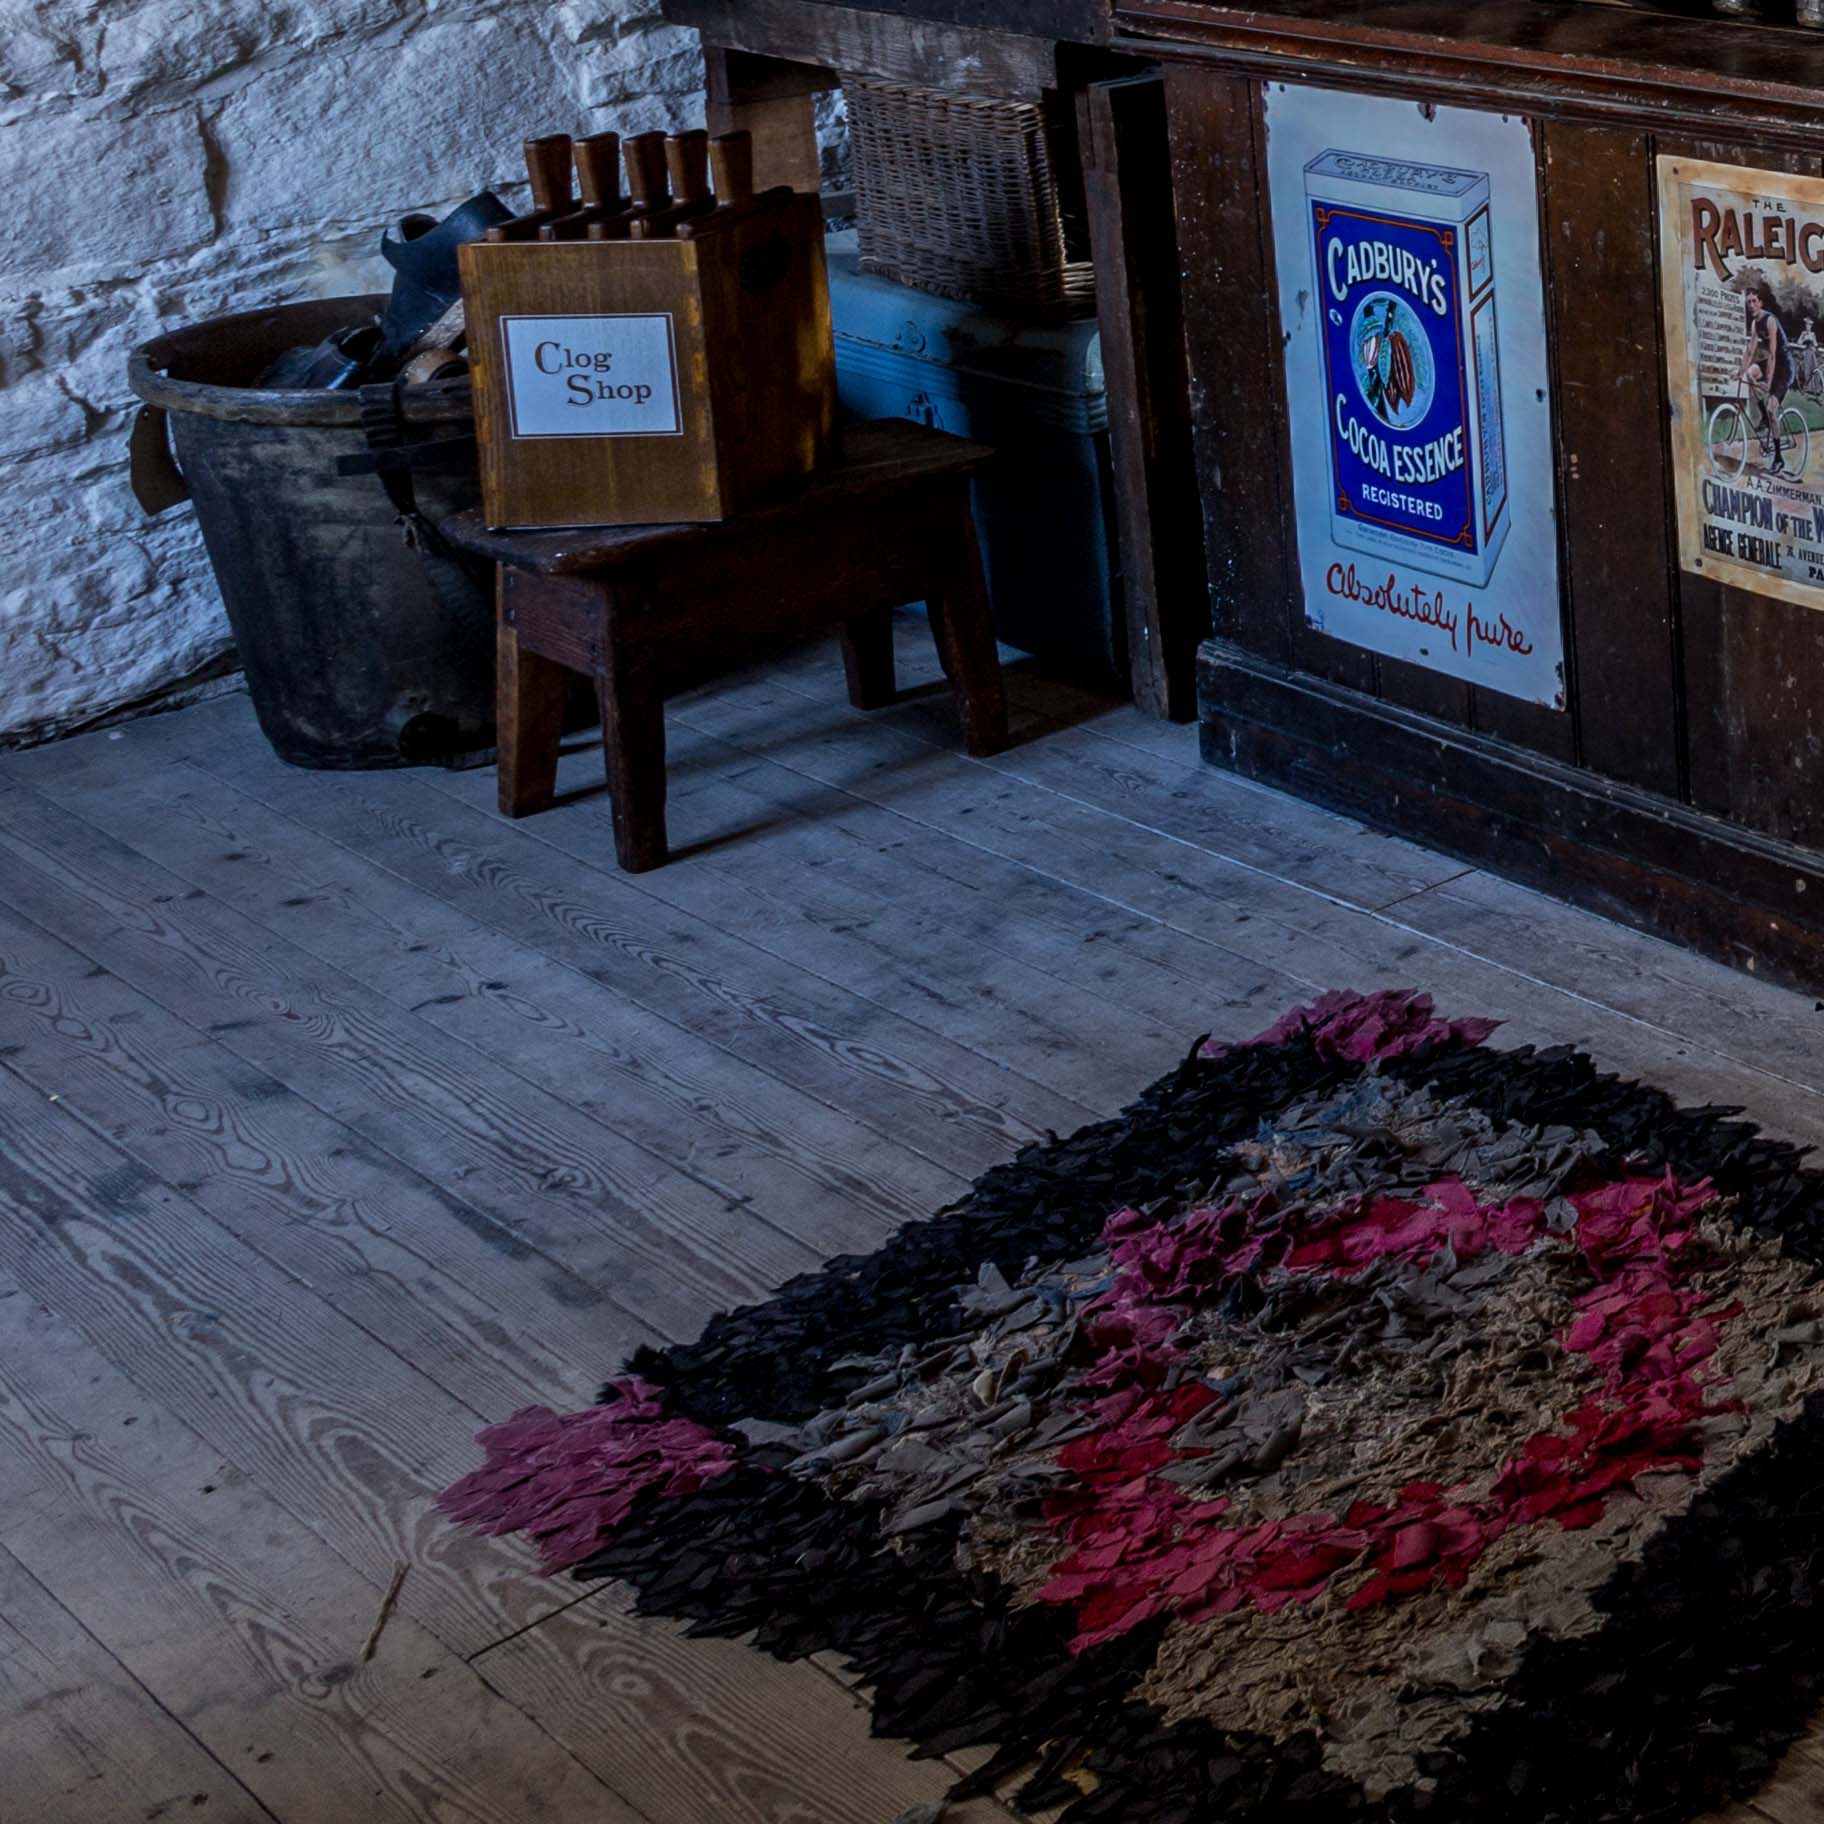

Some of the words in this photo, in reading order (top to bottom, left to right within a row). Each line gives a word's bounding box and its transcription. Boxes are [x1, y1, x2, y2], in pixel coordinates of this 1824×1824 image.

[1752, 199, 1787, 213] THE
[1327, 236, 1448, 317] CADBURY'S
[534, 340, 613, 375] Clog
[566, 373, 653, 407] Shop
[1336, 392, 1392, 478] COCOA
[1392, 425, 1465, 484] ESSENCE
[1361, 483, 1444, 521] REGISTERED
[1703, 479, 1774, 531] CHAMPION
[1776, 511, 1790, 534] OF
[1791, 515, 1814, 542] THE
[1703, 523, 1735, 557] AGENCE
[1799, 549, 1824, 566] AVENUE
[1326, 563, 1458, 651] Absolutely
[1467, 601, 1534, 657] pure
